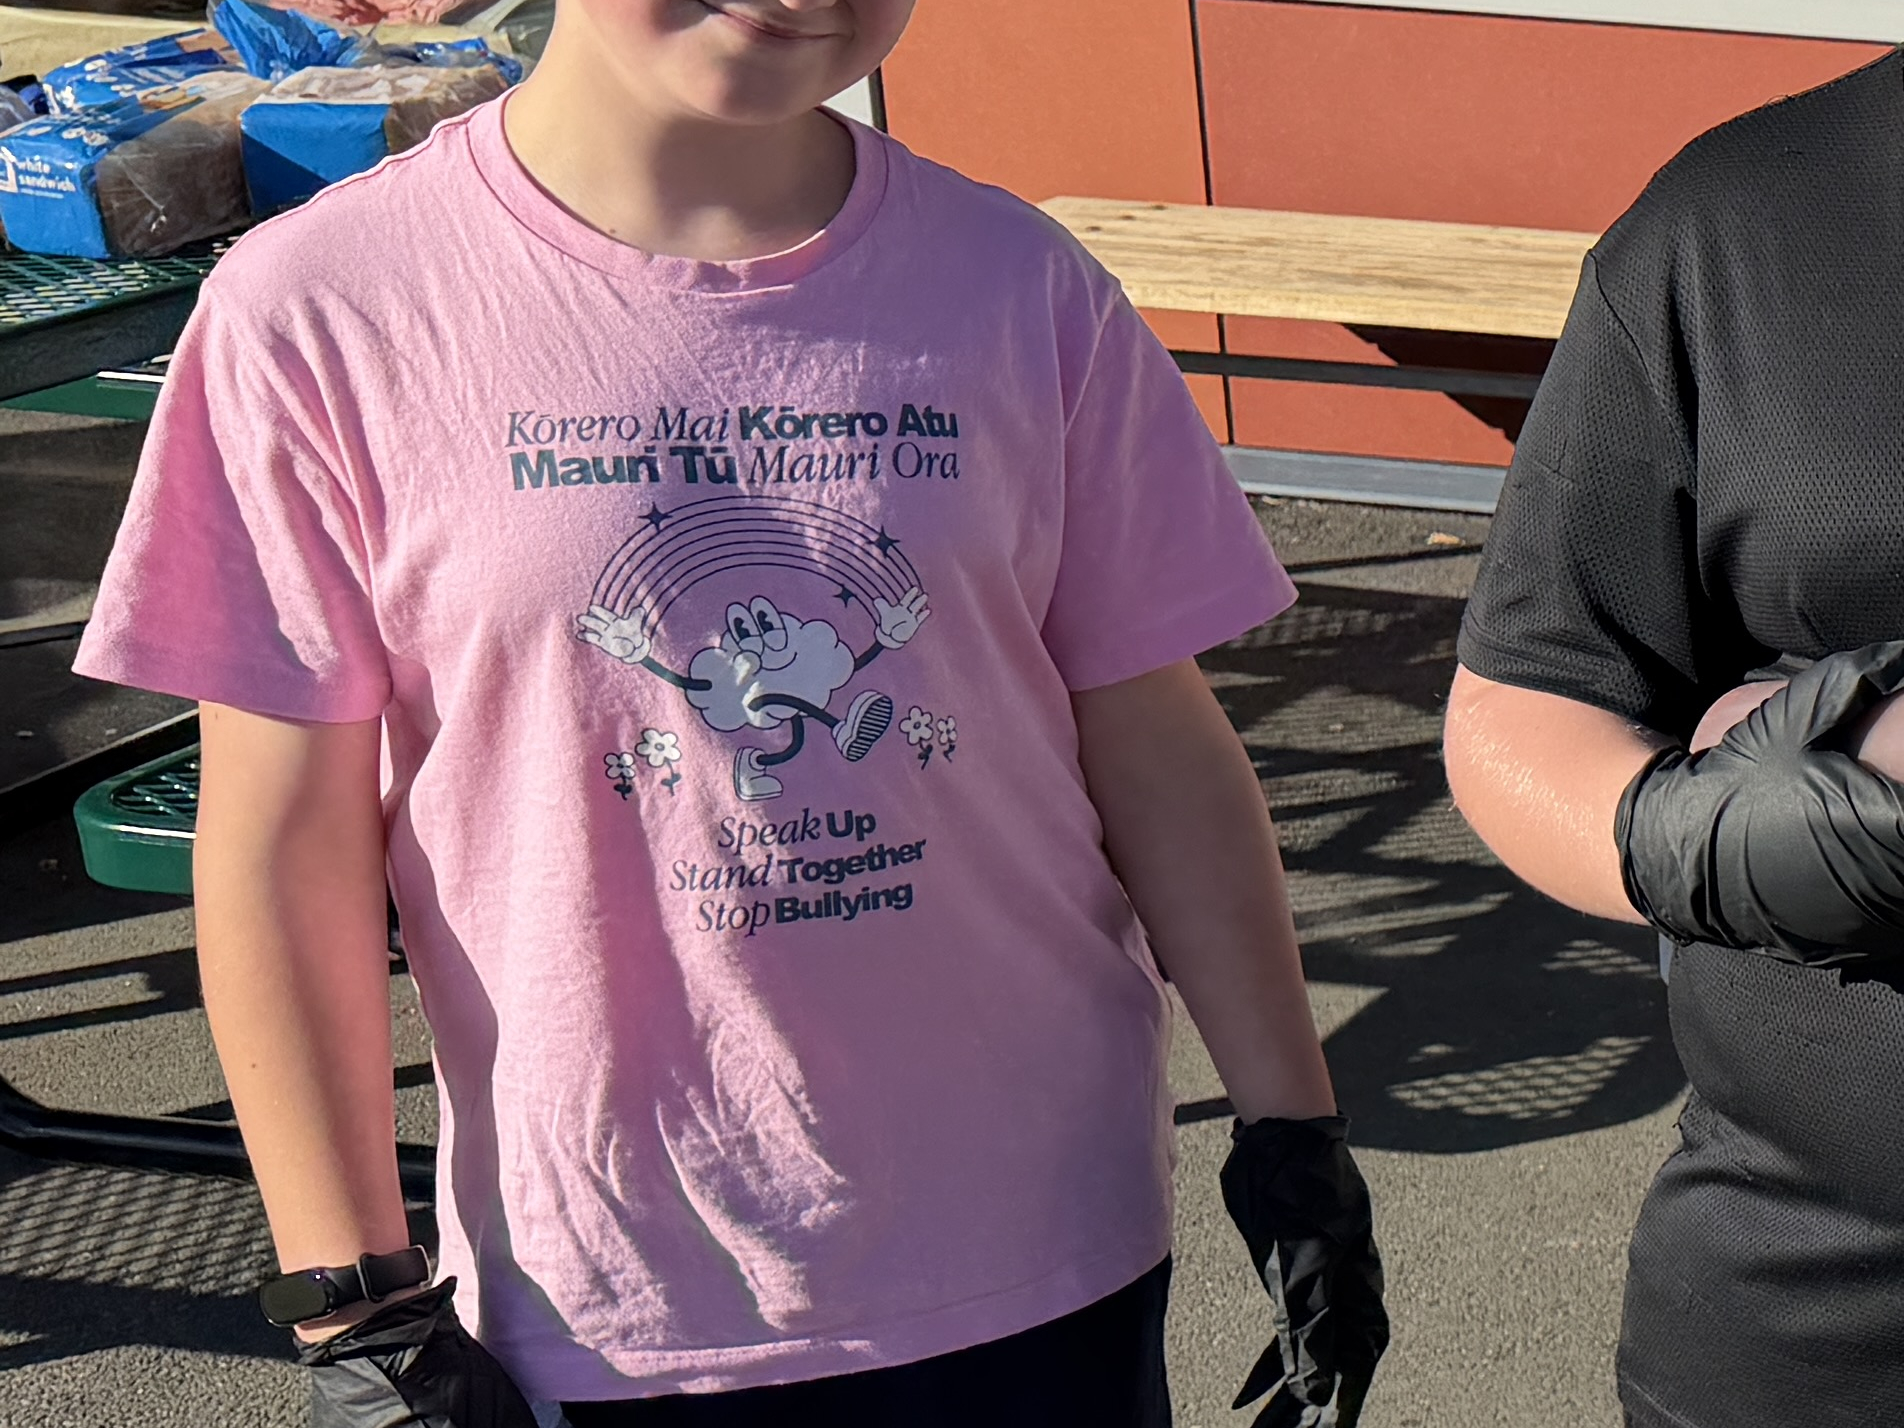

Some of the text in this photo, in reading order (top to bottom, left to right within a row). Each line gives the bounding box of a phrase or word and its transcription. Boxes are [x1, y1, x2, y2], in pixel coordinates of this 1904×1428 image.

[505, 403, 959, 447] Kōrero Mai Kōrero Atu
[509, 441, 961, 490] Mauri Tū Mauri Ora
[718, 807, 877, 856] Speak Up
[670, 839, 927, 891] Stand Together
[696, 883, 913, 938] Stop Bullying
